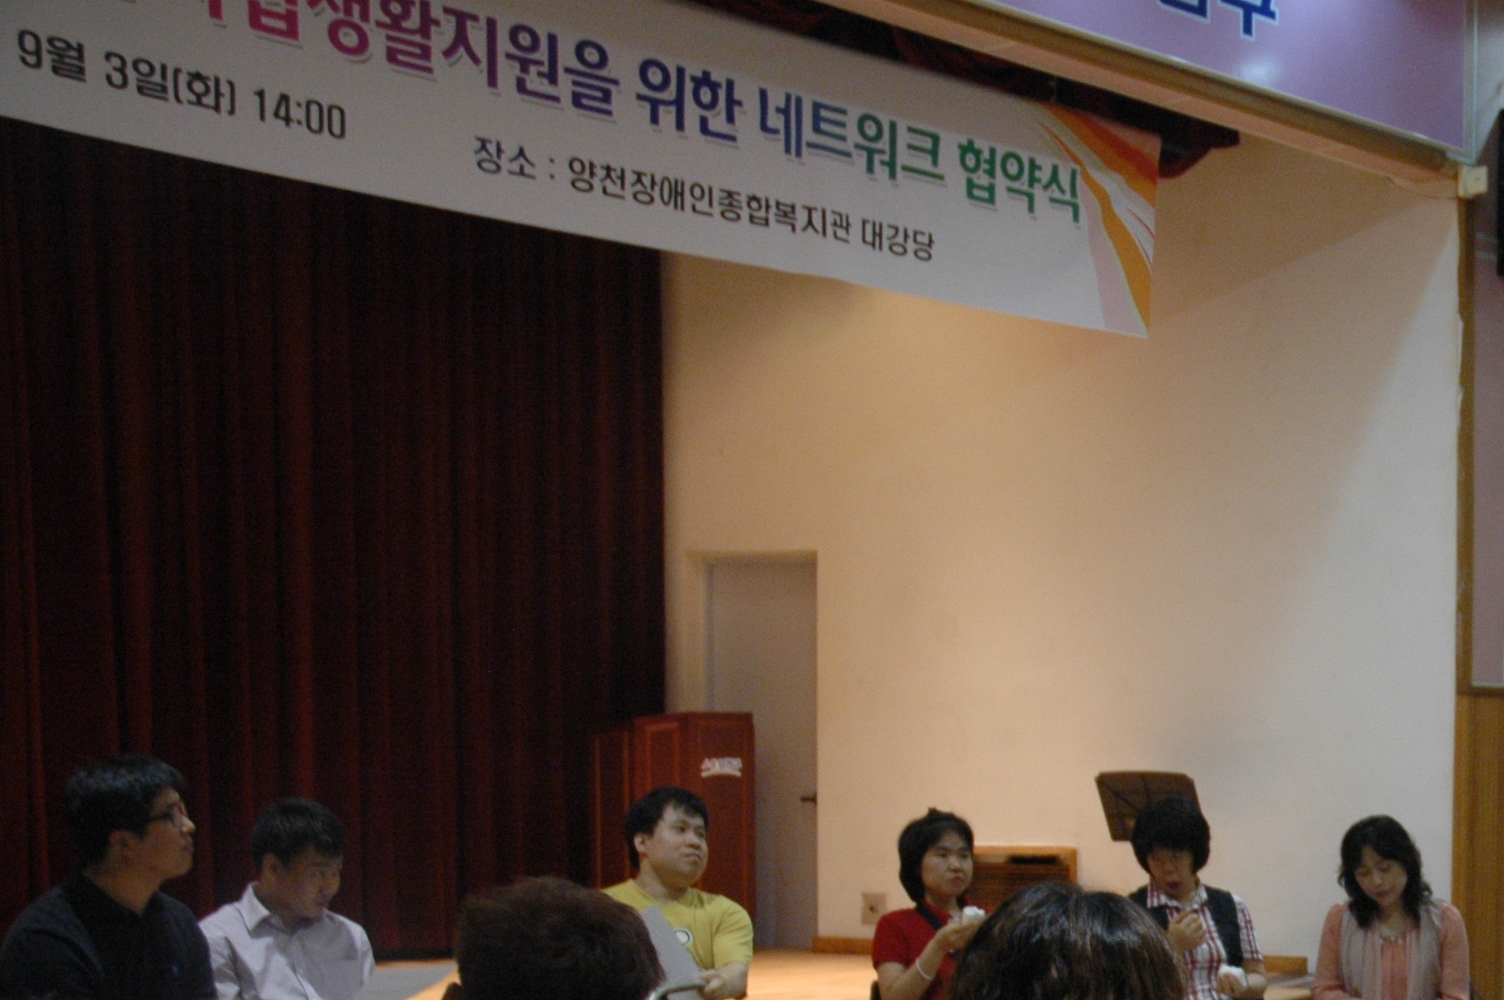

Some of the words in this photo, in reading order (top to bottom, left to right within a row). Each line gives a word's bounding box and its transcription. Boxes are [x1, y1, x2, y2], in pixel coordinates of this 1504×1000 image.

[17, 29, 87, 83] 9월
[253, 88, 347, 139] 14:00
[636, 58, 743, 143] 위한
[759, 86, 945, 181] 네트워크
[957, 137, 1080, 223] 협약식
[474, 136, 537, 180] 장소
[568, 157, 851, 244] 양천장애인종합복지관
[861, 217, 936, 262] 대강당
